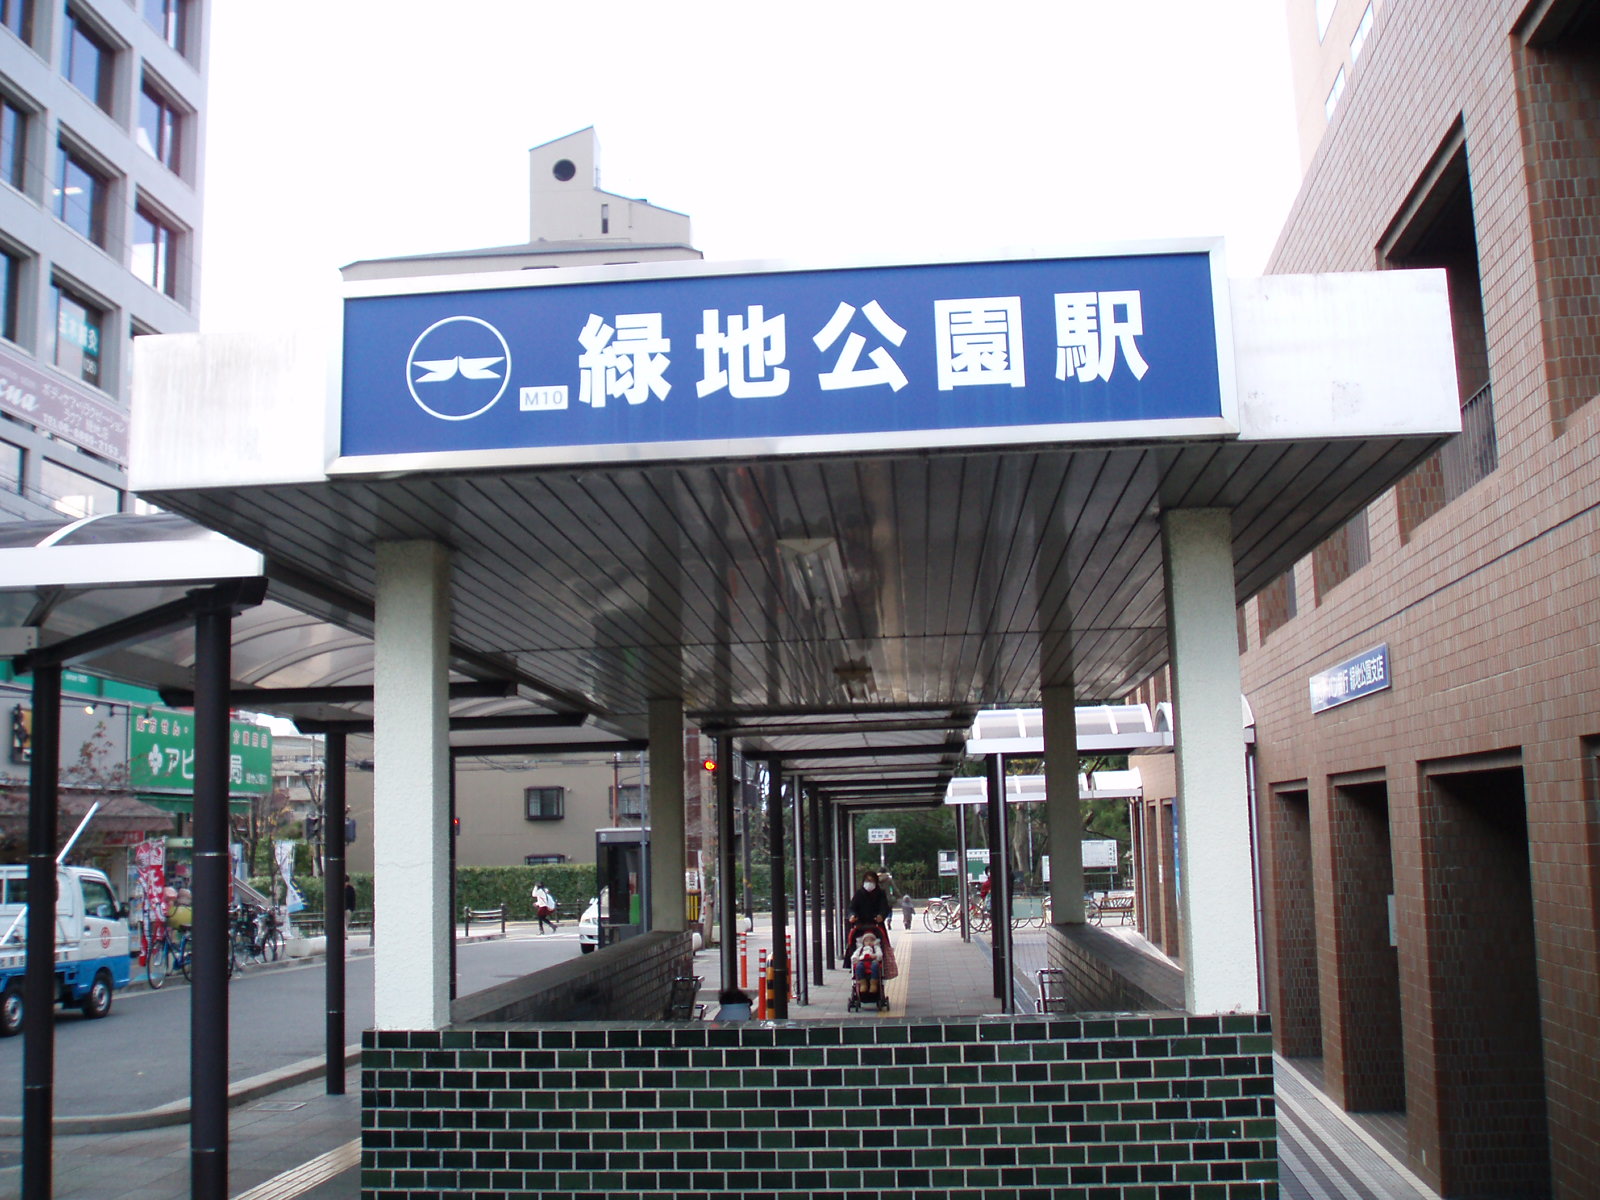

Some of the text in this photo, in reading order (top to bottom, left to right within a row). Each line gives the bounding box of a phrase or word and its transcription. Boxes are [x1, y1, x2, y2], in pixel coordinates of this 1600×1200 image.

[577, 289, 1150, 408] 緑地公園駅
[523, 388, 565, 408] M10
